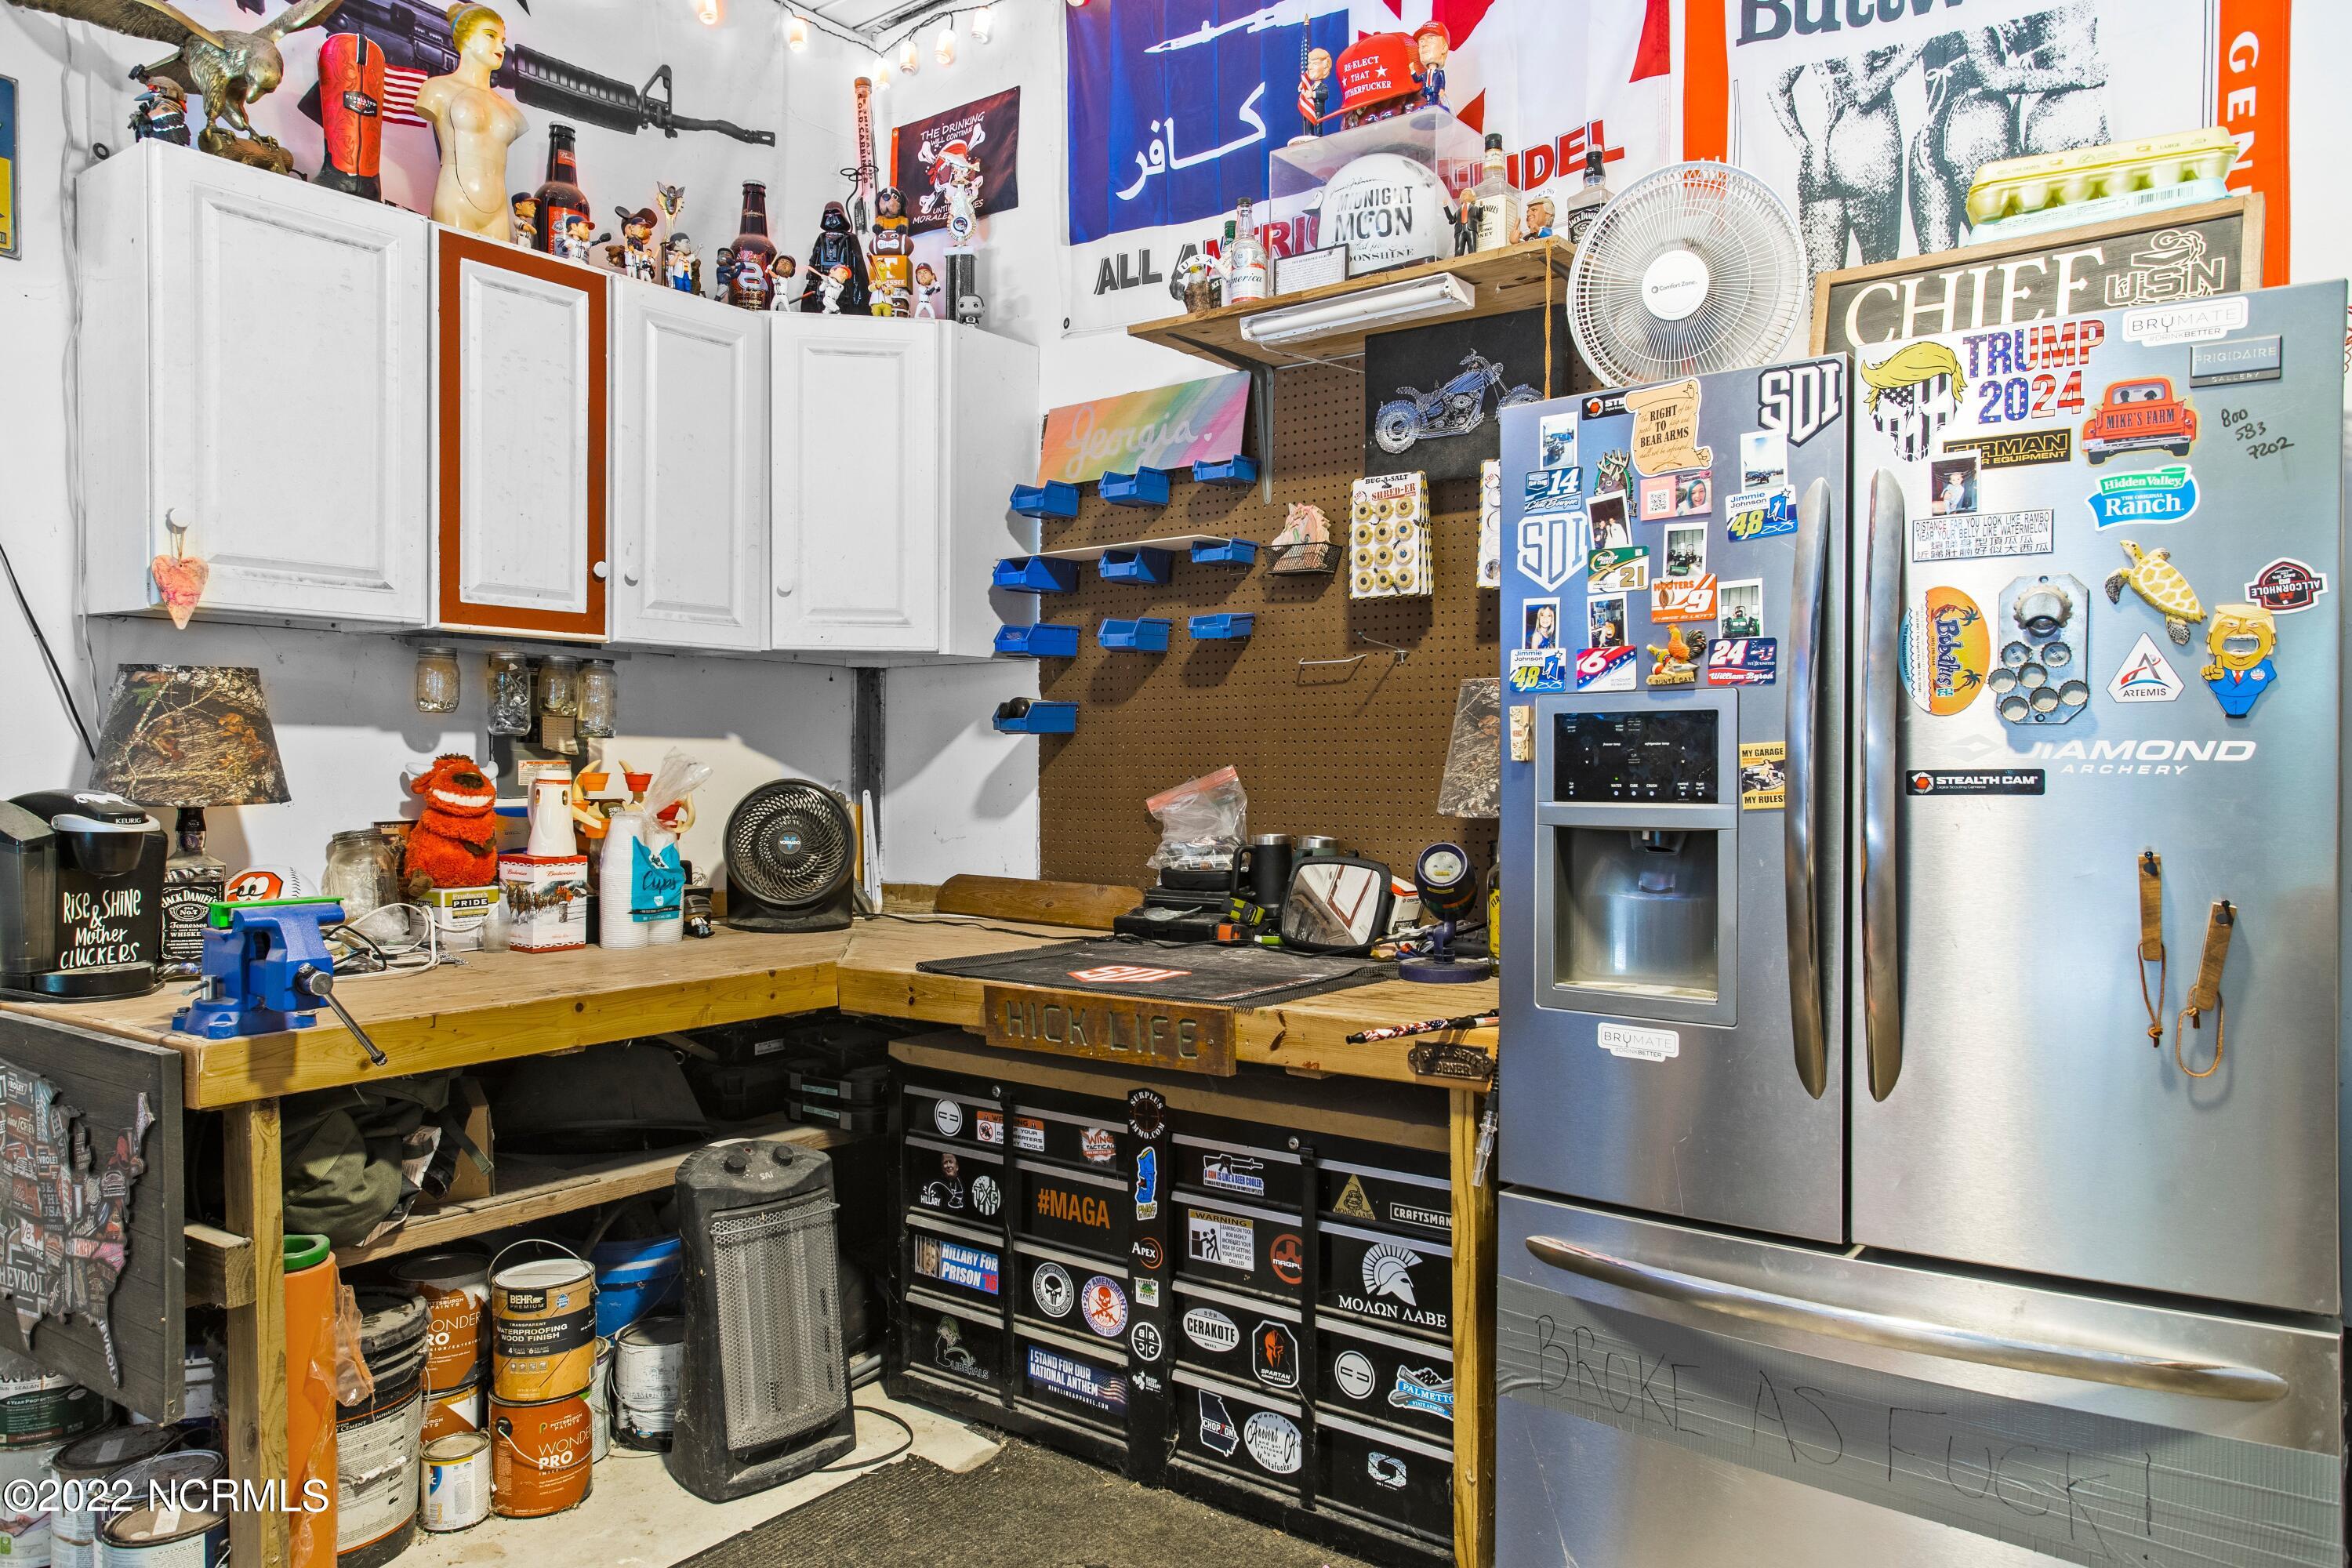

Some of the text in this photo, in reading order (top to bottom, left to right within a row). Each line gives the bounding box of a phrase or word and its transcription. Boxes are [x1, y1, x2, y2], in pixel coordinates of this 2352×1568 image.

[1344, 56, 1379, 72] RE-ELECT
[1350, 71, 1370, 83] THAT
[920, 111, 985, 141] THE DRINKING
[946, 125, 973, 142] CONTINUE
[1116, 81, 1266, 201] كافر
[1336, 186, 1414, 212] MIDNIGHT
[1334, 206, 1413, 242] MOON
[1094, 248, 1163, 296] ALL
[1659, 282, 1681, 291] Comfort
[1845, 246, 2225, 348] CHIEF USN
[2149, 328, 2221, 342] #DRINKBETTER
[1962, 318, 2107, 379] TRUMP
[2195, 346, 2277, 365] FRIGIDAIRE
[2212, 372, 2259, 383] GALLERY
[1977, 369, 2085, 426] 2024
[1650, 405, 1678, 422] RIGHT
[2107, 408, 2176, 430] MIKE'S FARM
[2221, 408, 2249, 428] 800
[1655, 419, 1667, 432] TO
[2235, 420, 2267, 441] 583
[1065, 405, 1194, 482] Georgia
[1640, 426, 1690, 448] BEAR ARMS
[1994, 450, 2067, 464] EQUIPMENT
[2246, 436, 2295, 459] 7202
[1365, 474, 1409, 485] BUG-A-SALT
[1547, 468, 1580, 495] 14
[2103, 475, 2147, 490] Hidden
[1371, 482, 1416, 501] SHRED-ER
[1730, 492, 1766, 503] Jimmie
[1730, 499, 1767, 509] Johnson
[2104, 495, 2183, 517] Ranch
[1730, 509, 1765, 537] 48
[1916, 511, 2049, 532] DISTANCE FAR YOU LOOK LIKE RAMBO
[1917, 522, 2049, 542] NEAR YOUR BELLY LIKE WATERMELON
[1620, 565, 1644, 587] 21
[1653, 580, 1694, 591] HOOTERS
[2251, 579, 2321, 597] ALLCORNHOLE
[1684, 589, 1714, 613] 9
[1708, 640, 1749, 666] 24
[1513, 666, 1540, 688] 48
[1708, 671, 1773, 681] William Byron
[2123, 688, 2167, 698] ARTEMIS
[1742, 747, 1784, 757] MY GARAGE
[2060, 764, 2189, 775] ARCHERY
[1936, 775, 2034, 785] STEALTH CAM
[1744, 796, 1756, 804] MY
[642, 870, 677, 895] Cups
[162, 892, 183, 909] JACK
[453, 898, 488, 907] PRIDE
[90, 905, 103, 929] &
[75, 924, 129, 947] Mother
[60, 942, 140, 969] CLUCKERS
[1006, 999, 1200, 1060] HICK LIFE
[1614, 1047, 1662, 1058] #DRINKBETTER
[1130, 1091, 1163, 1109] SURPLUS
[1129, 1119, 1165, 1139] AMMO.COM
[1022, 1142, 1044, 1150] TOOLS
[920, 1194, 941, 1207] HILLARY
[1037, 1187, 1111, 1229] #MAGA
[1196, 1212, 1247, 1227] WARNING
[1393, 1207, 1452, 1226] CRAFTSMAN
[941, 1244, 999, 1272] HILLARY FOR
[941, 1263, 982, 1287] PRISON
[510, 1294, 533, 1304] BEHR
[1092, 1276, 1127, 1316] AMENDMENT
[496, 1323, 568, 1335] WATERPROOFING
[528, 1332, 560, 1342] FINISH
[1187, 1317, 1236, 1343] CERAKOTE
[950, 1360, 989, 1380] LIBERALS
[1034, 1350, 1091, 1381] STAND FOR OUR
[1261, 1368, 1290, 1380] SPARTAN
[1030, 1363, 1098, 1397] NATIONAL ANTHEM
[1534, 1314, 1706, 1436] BROKE
[1751, 1370, 1844, 1466] AS
[340, 1421, 367, 1432] CEMENT
[550, 1414, 583, 1428] PITTSBURGH
[554, 1419, 580, 1431] PAINTS
[1203, 1419, 1234, 1437] CHOP ON
[539, 1450, 573, 1471] PRO
[1258, 1451, 1293, 1472] Muthafucker
